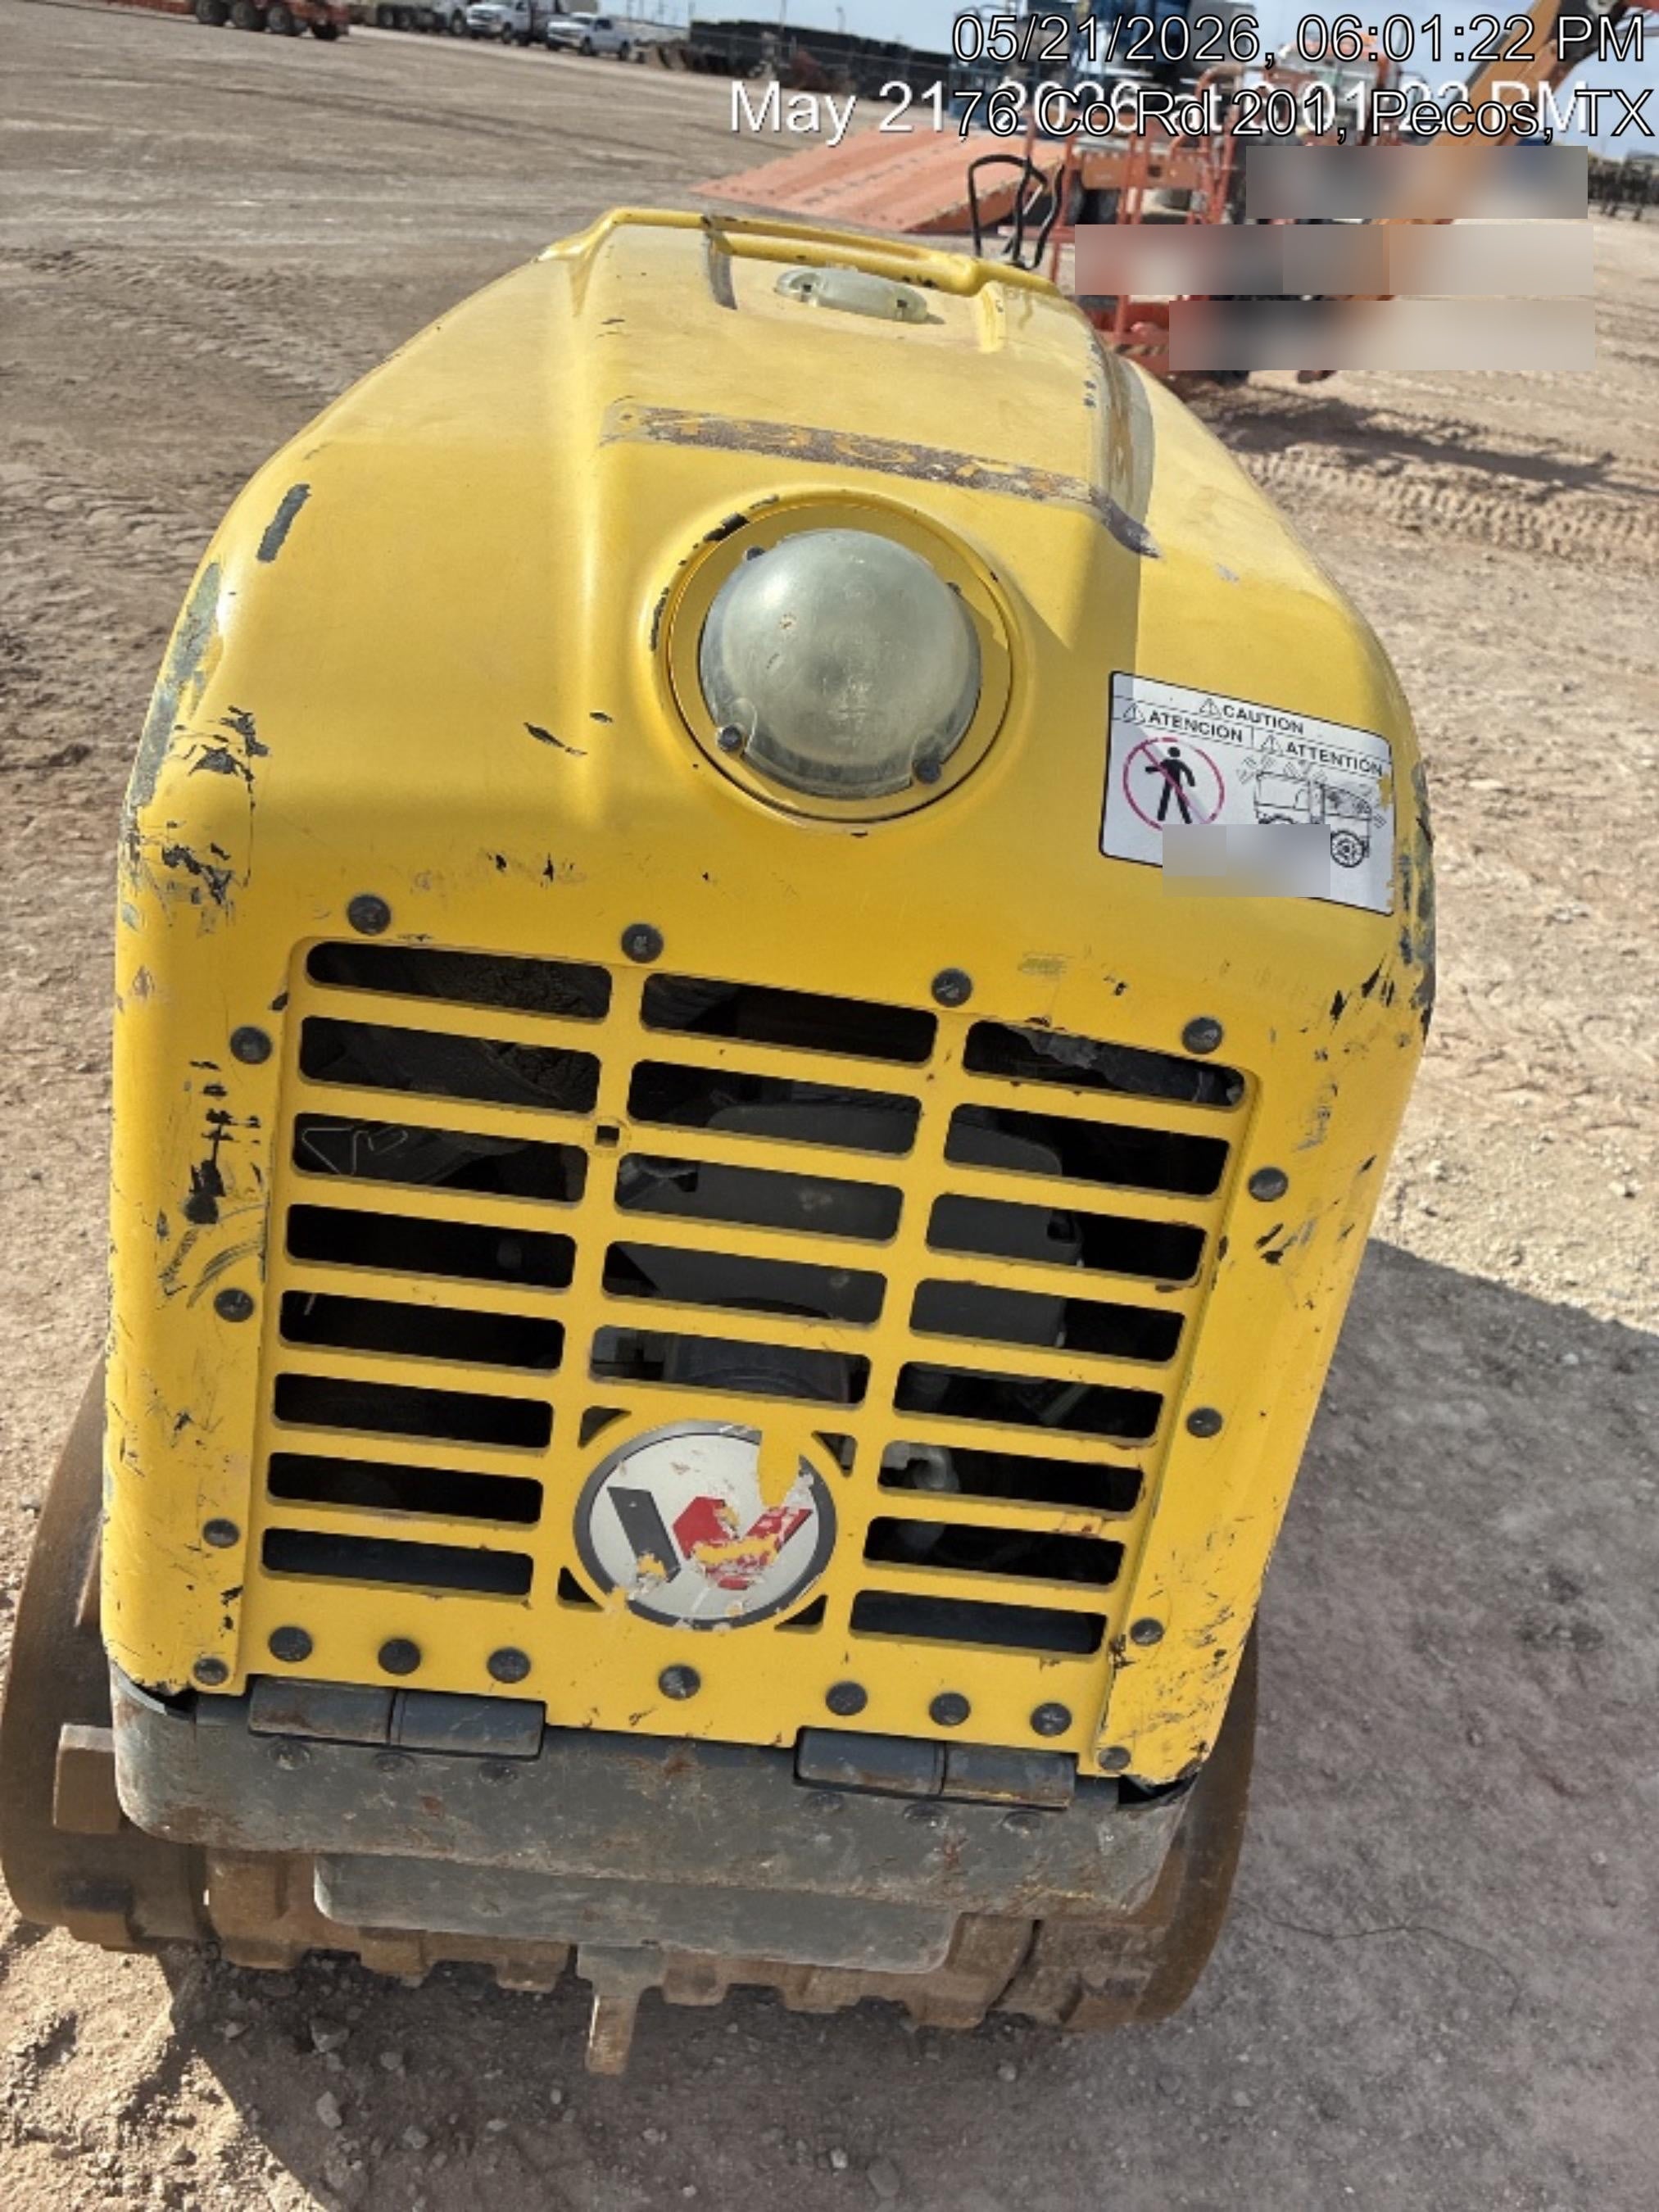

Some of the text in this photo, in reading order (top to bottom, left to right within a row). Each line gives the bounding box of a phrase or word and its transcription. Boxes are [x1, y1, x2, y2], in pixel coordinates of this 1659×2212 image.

[1149, 710, 1243, 742] ATENCION
[1223, 704, 1304, 735] CAUTION
[1285, 741, 1383, 777] ATTENTION
